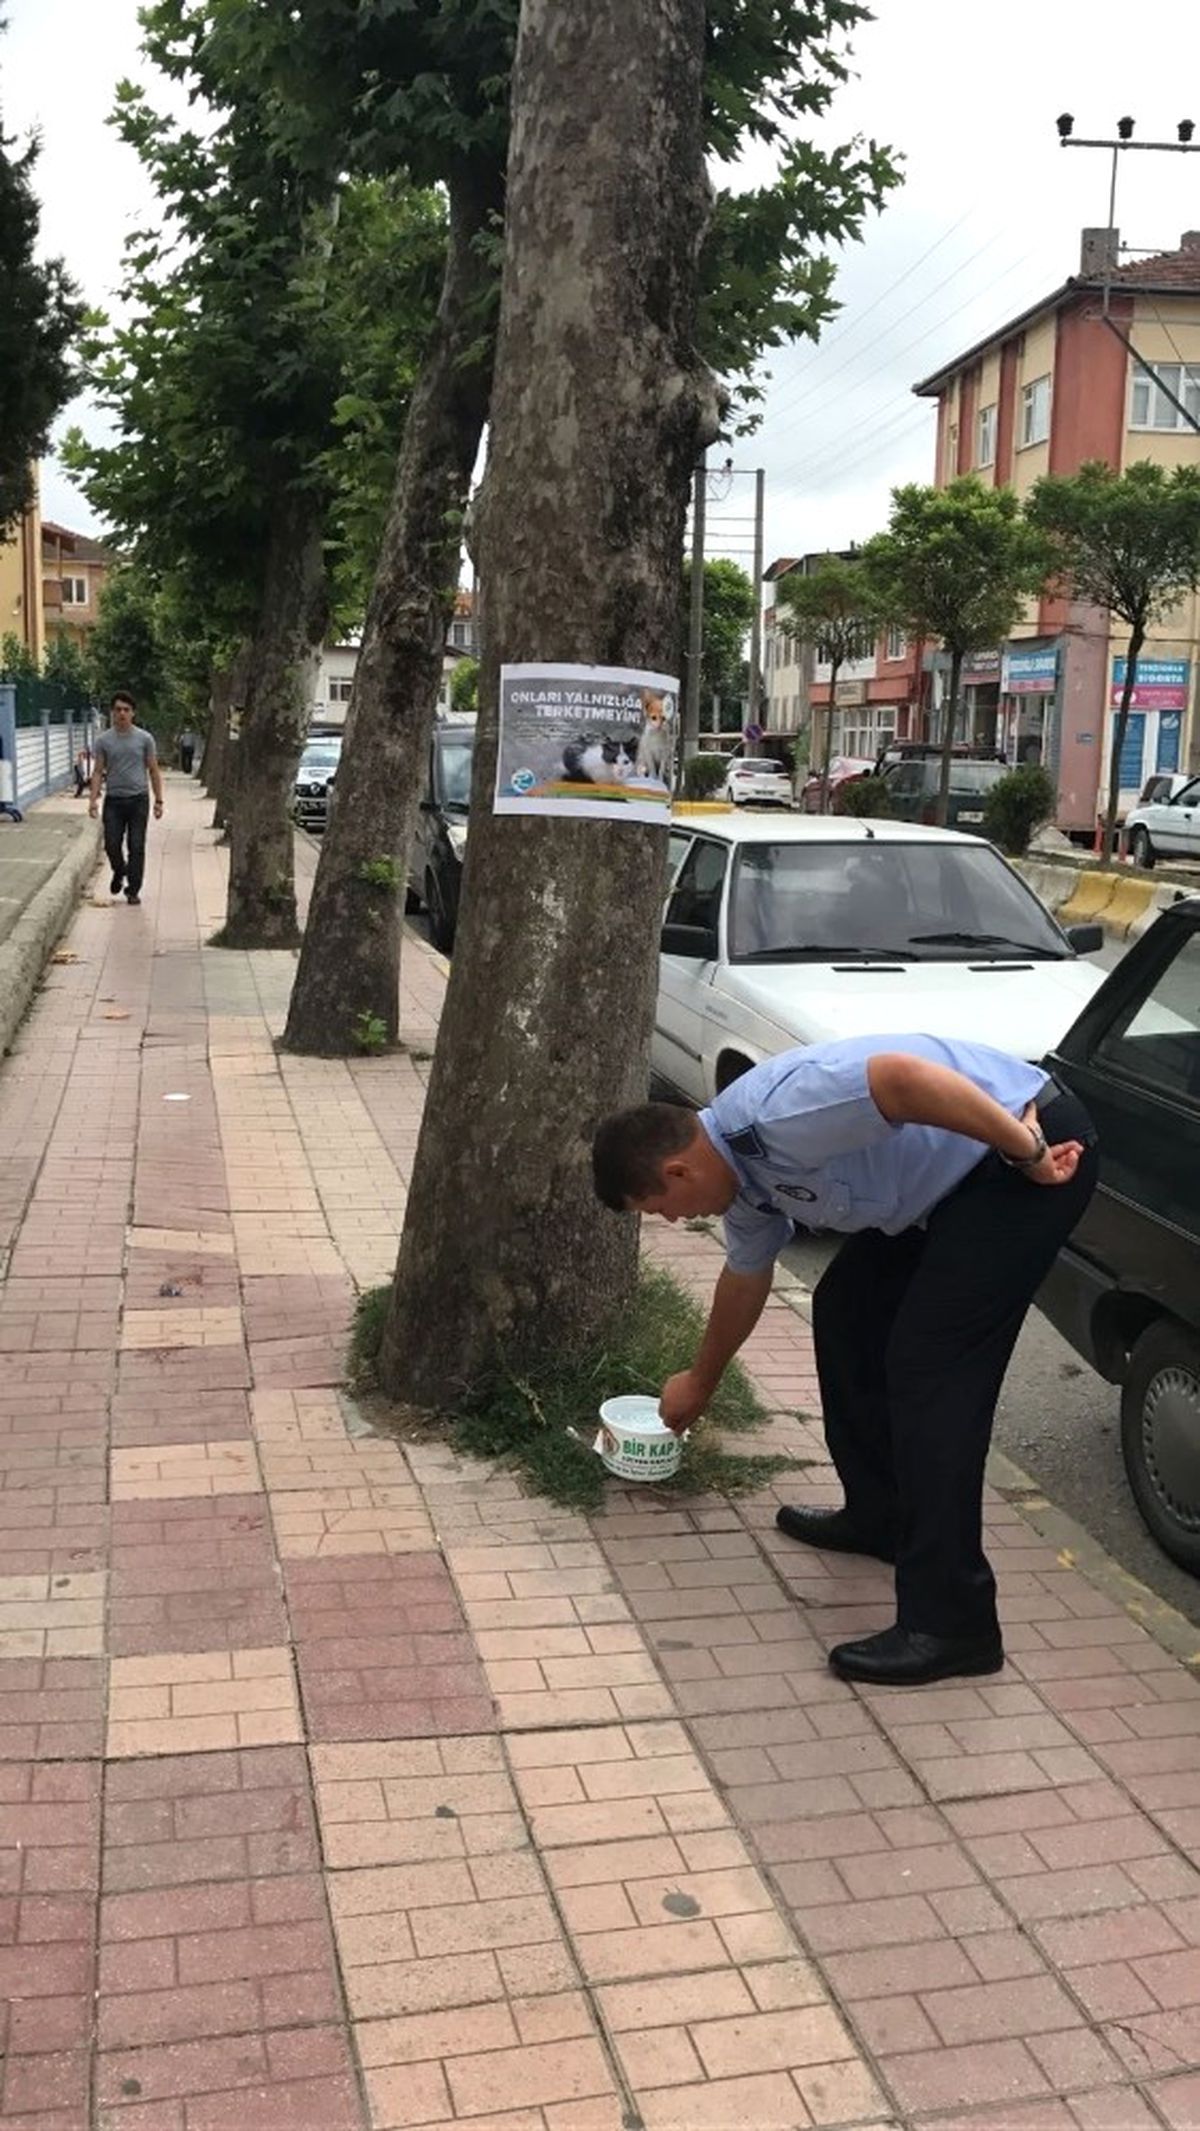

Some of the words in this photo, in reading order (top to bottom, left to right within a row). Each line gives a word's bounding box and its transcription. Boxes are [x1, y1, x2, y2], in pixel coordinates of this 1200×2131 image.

[511, 691, 561, 703] ONLARI
[565, 692, 641, 709] YALNIZLIĞA
[623, 1438, 645, 1456] BİR
[650, 1442, 674, 1457] KAP
